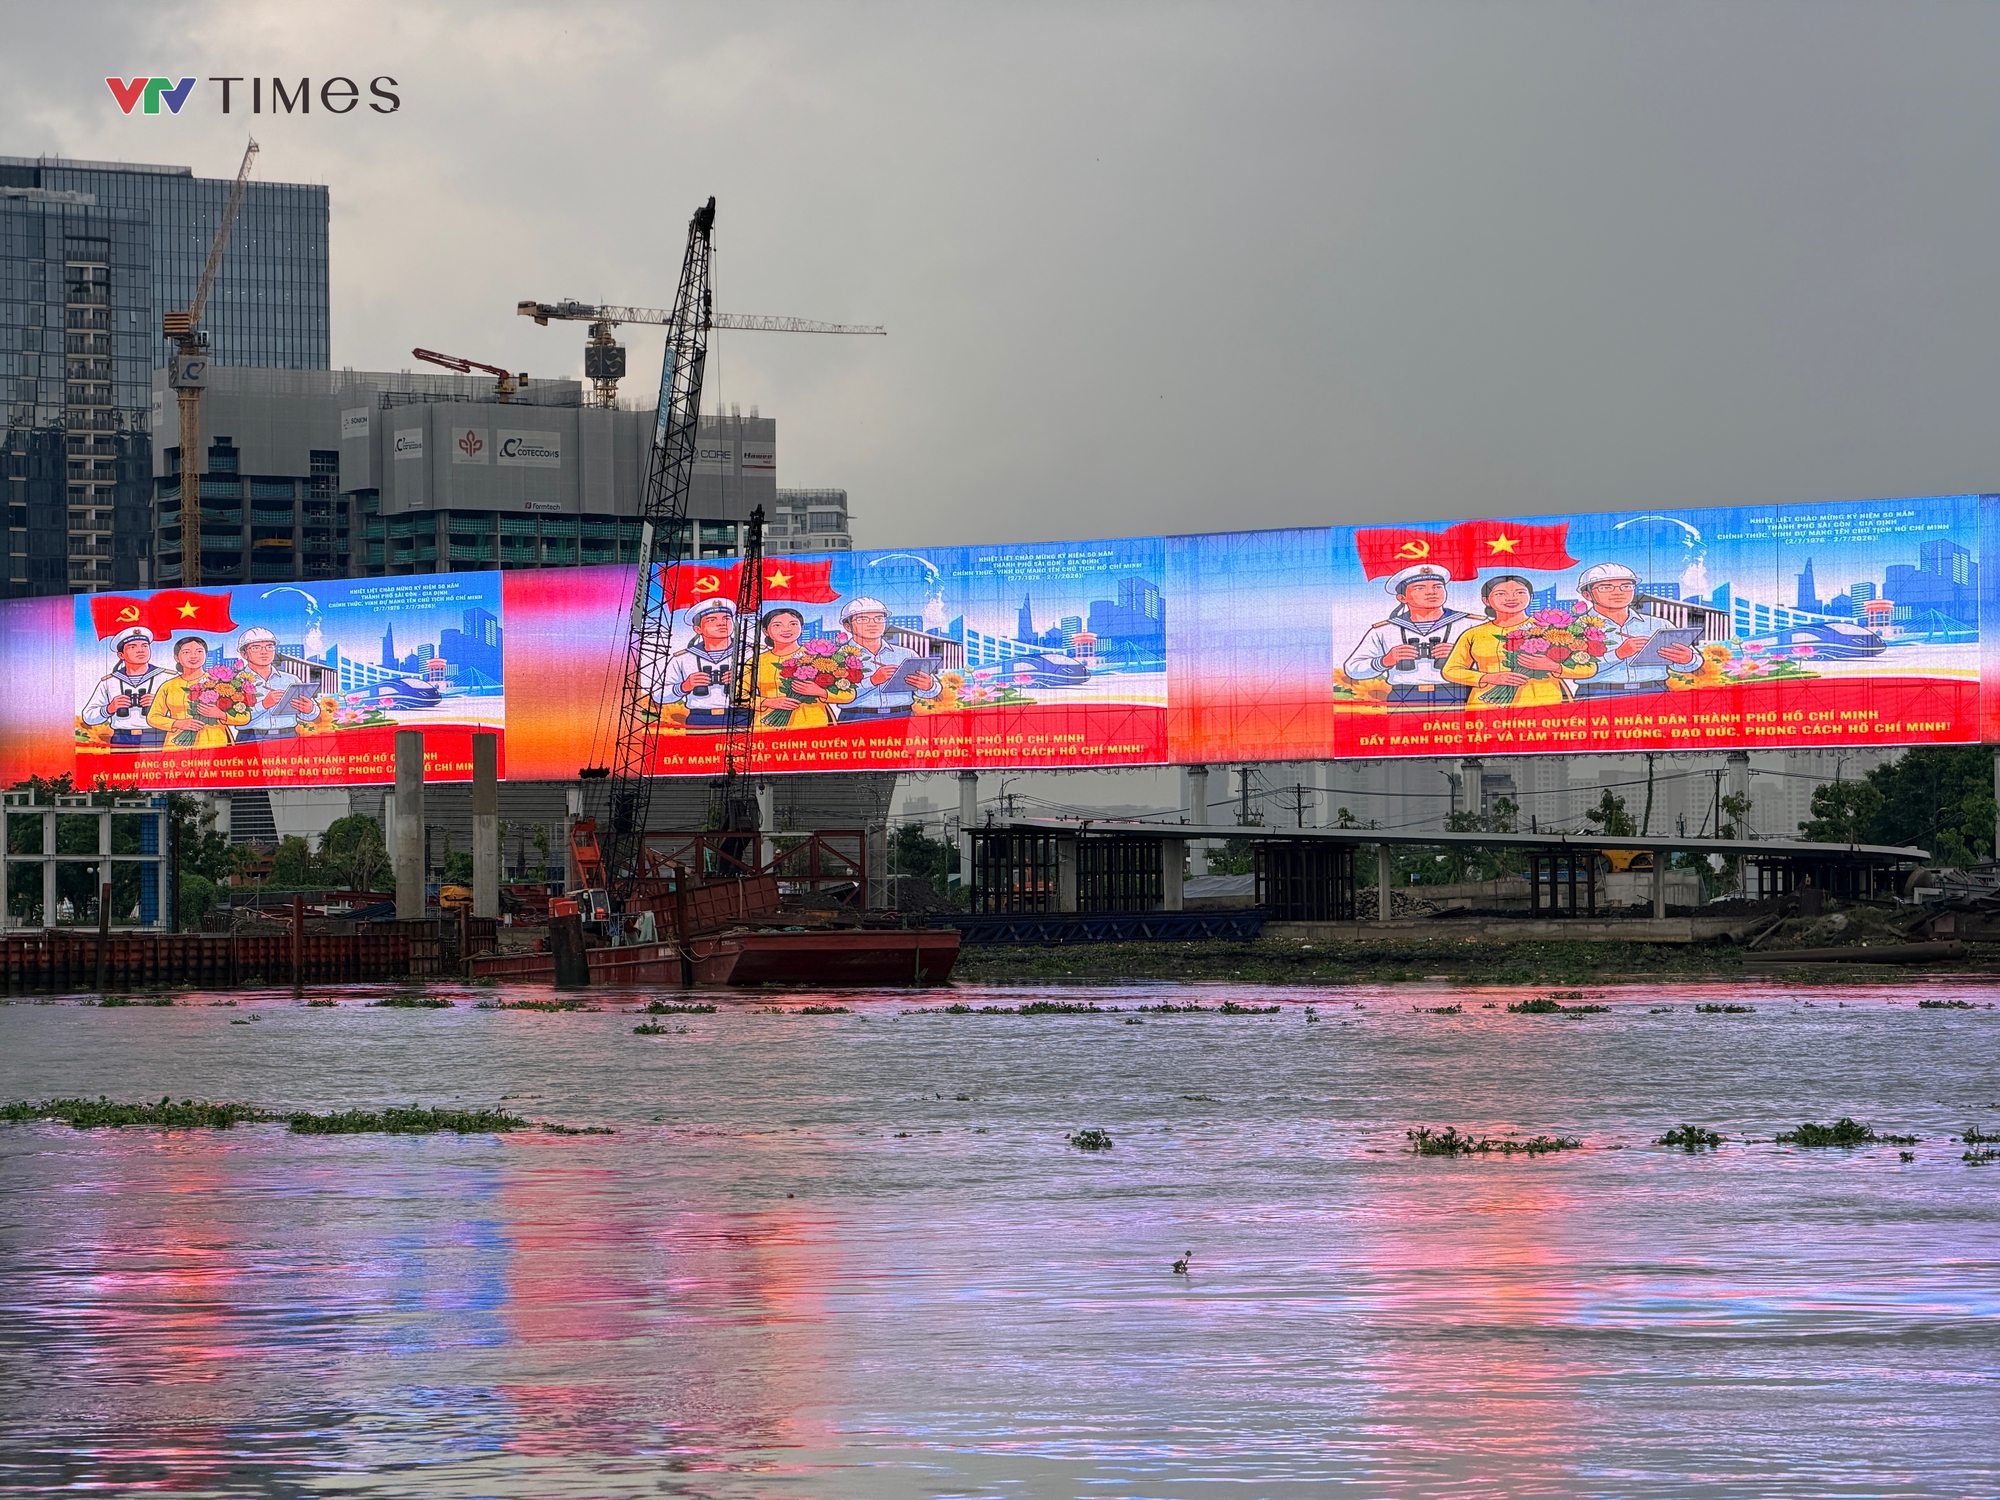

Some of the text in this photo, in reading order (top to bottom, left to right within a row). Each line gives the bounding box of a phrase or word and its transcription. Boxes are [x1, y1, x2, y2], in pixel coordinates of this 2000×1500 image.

[701, 450, 731, 459] CORE
[533, 502, 560, 510] Formtech
[635, 543, 648, 609] Nutifood
[1423, 720, 1460, 730] ĐẢNG
[1492, 718, 1536, 729] CHÍNH
[1591, 716, 1608, 726] VÀ
[1614, 715, 1652, 726] NHÂN
[1658, 714, 1686, 724] DÂN
[1693, 712, 1740, 724] THÀNH
[1746, 712, 1776, 722] PHỐ
[1782, 711, 1803, 721] HỒ
[1808, 710, 1834, 721] CHÍ
[1840, 711, 1878, 720] MINH
[771, 739, 807, 749] CHÍNH
[851, 738, 865, 747] VÀ
[869, 737, 901, 747] NHÂN
[905, 736, 928, 746] DÂN
[934, 735, 972, 746] THÀNH
[976, 734, 1001, 745] PHỐ
[1006, 734, 1023, 744] HỒ
[1027, 733, 1048, 743] CHÍ
[1053, 735, 1084, 743] MINH
[1390, 736, 1428, 746] MẠNH
[1434, 735, 1462, 745] HỌC
[1467, 732, 1492, 744] TẬP
[1497, 732, 1513, 742] VÀ
[1519, 731, 1546, 741] LÀM
[1551, 732, 1586, 740] THEO
[1591, 729, 1609, 739] TƯ
[1671, 729, 1700, 739] ĐẠO
[1745, 726, 1796, 735] PHONG
[1802, 723, 1842, 734] CÁCH
[1848, 722, 1868, 733] HỒ
[1874, 721, 1900, 732] CHÍ
[134, 759, 159, 768] ĐẢNG
[181, 757, 210, 767] CHÍNH
[247, 756, 258, 765] VÀ
[262, 755, 287, 764] NHÂN
[290, 754, 309, 764] DÂN
[313, 753, 344, 763] THÀNH
[349, 753, 369, 762] PHỐ
[373, 752, 386, 761] HỒ
[688, 755, 720, 765] MẠNH
[751, 752, 771, 764] TẬP
[775, 751, 789, 761] VÀ
[793, 751, 815, 761] LÀM
[820, 752, 848, 760] THEO
[852, 749, 866, 759] TƯ
[915, 750, 940, 759] ĐẠO
[976, 748, 1018, 756] PHONG
[1022, 745, 1055, 755] CÁCH
[1059, 744, 1077, 754] HỒ
[1081, 744, 1103, 754] CHÍ
[112, 773, 138, 782] MẠNH
[141, 772, 161, 781] HỌC
[164, 769, 181, 780] TẬP
[184, 769, 195, 778] VÀ
[198, 768, 217, 778] LÀM
[247, 767, 258, 776] TƯ
[298, 768, 319, 777] ĐẠO
[348, 766, 382, 774] PHONG
[434, 762, 452, 771] CHÍ
